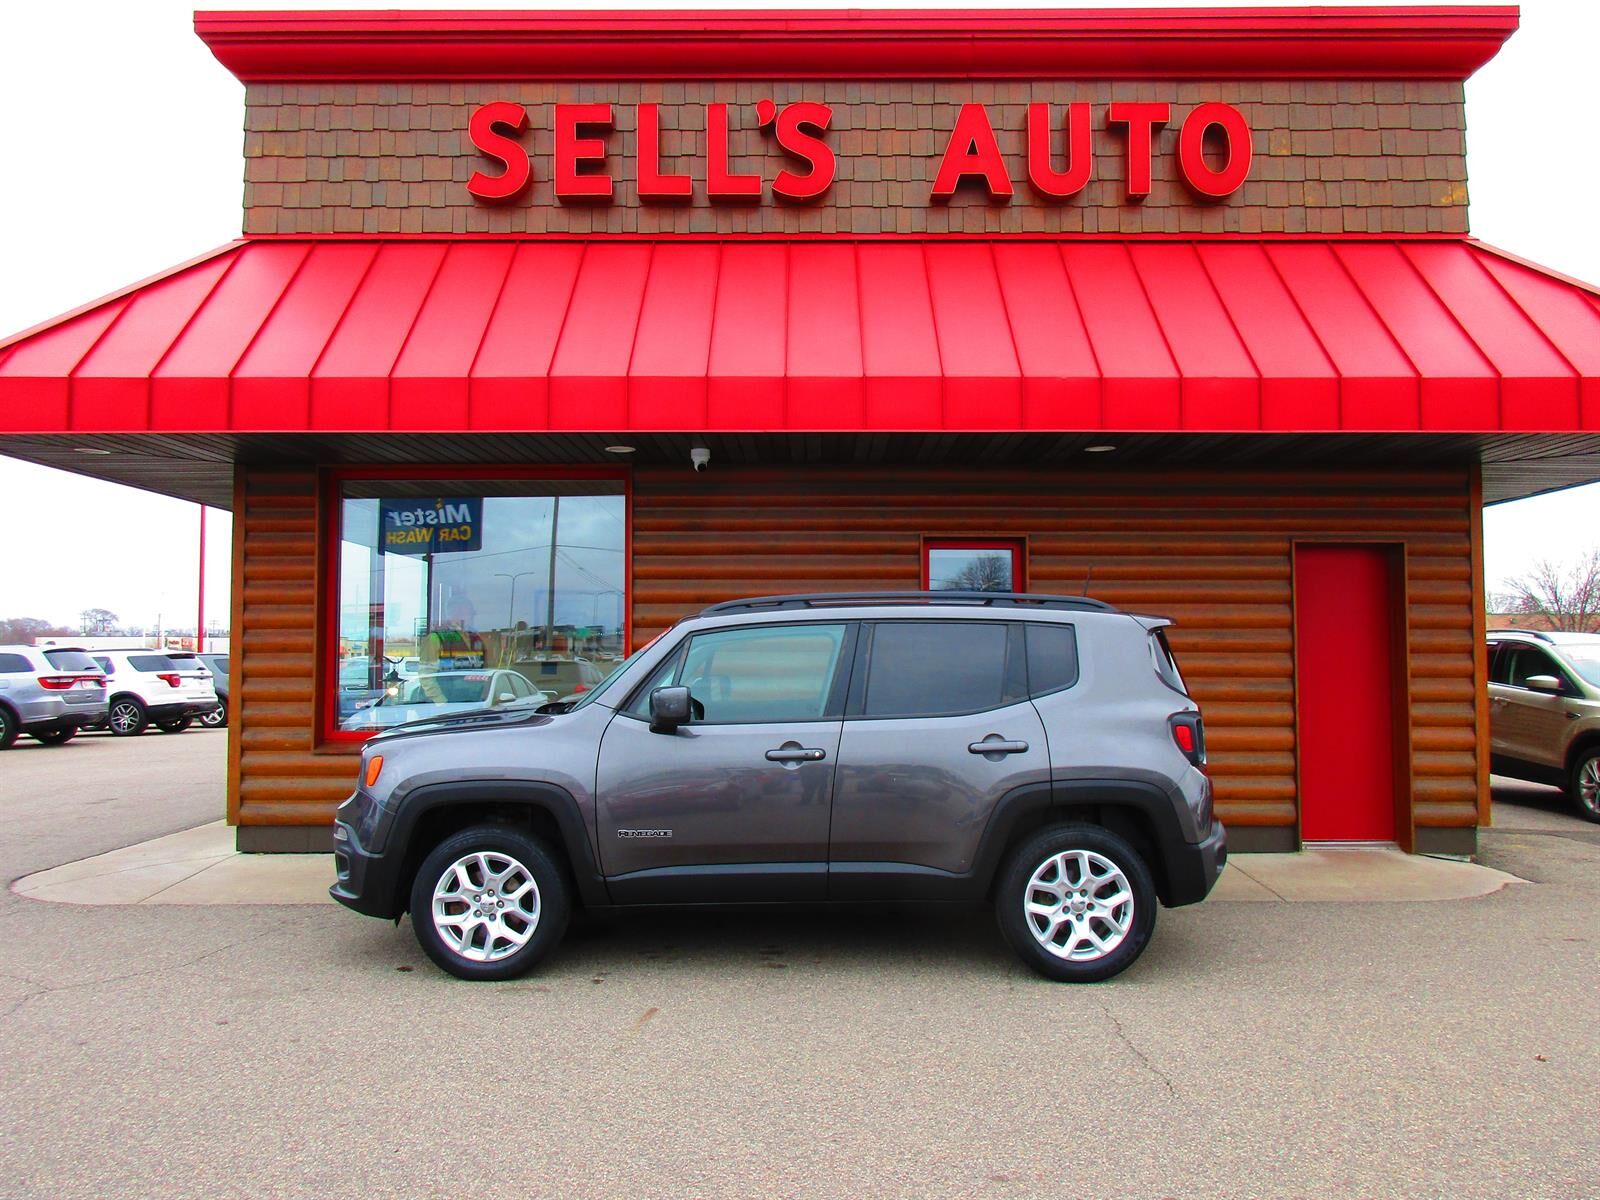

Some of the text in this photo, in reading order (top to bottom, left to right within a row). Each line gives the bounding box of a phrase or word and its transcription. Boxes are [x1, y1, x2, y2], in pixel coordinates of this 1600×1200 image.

[466, 98, 1254, 201] SELL'S AUTO
[617, 829, 673, 838] RENEGADE
